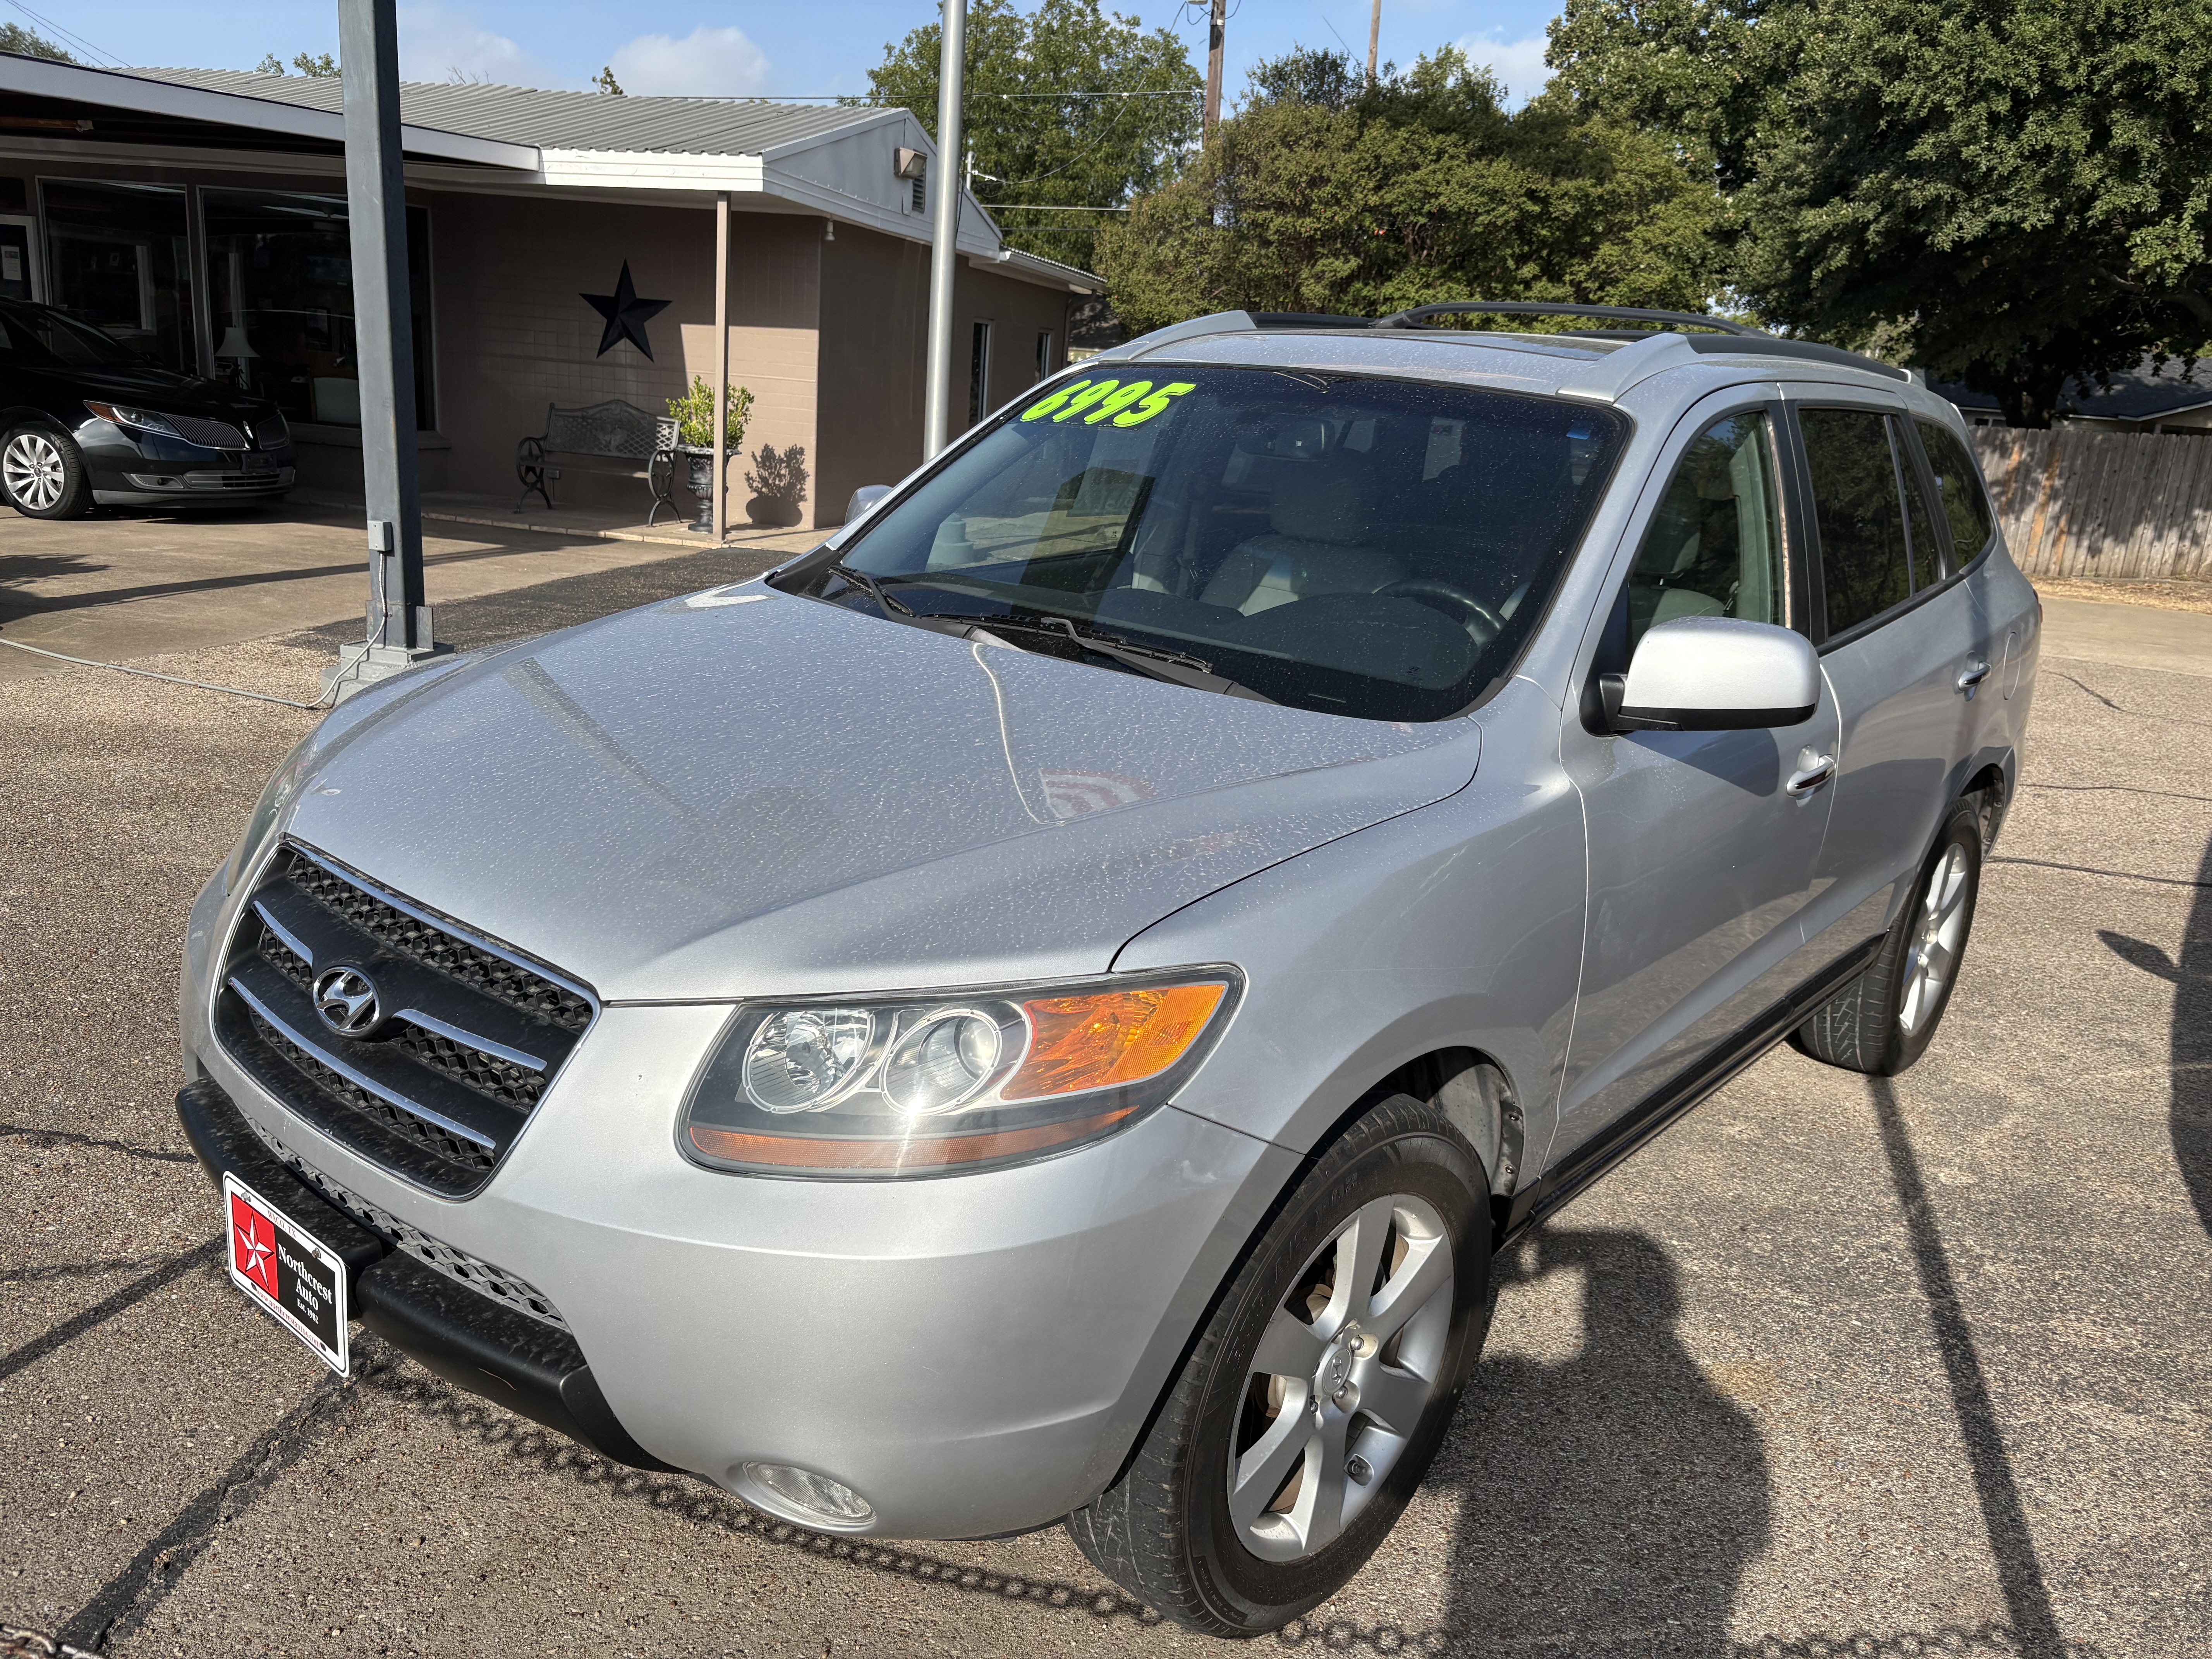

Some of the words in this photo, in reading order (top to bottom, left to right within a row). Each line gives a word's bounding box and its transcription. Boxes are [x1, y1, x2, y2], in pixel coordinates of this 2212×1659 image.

[1020, 380, 1196, 427] 6995
[267, 1209, 286, 1231] WACO,
[288, 1226, 296, 1238] TX
[277, 1243, 332, 1304] Northcrest
[295, 1278, 319, 1310] Auto
[297, 1298, 306, 1313] Est.
[307, 1308, 319, 1324] 1982
[256, 1290, 320, 1348] www.northcrestautos.com
